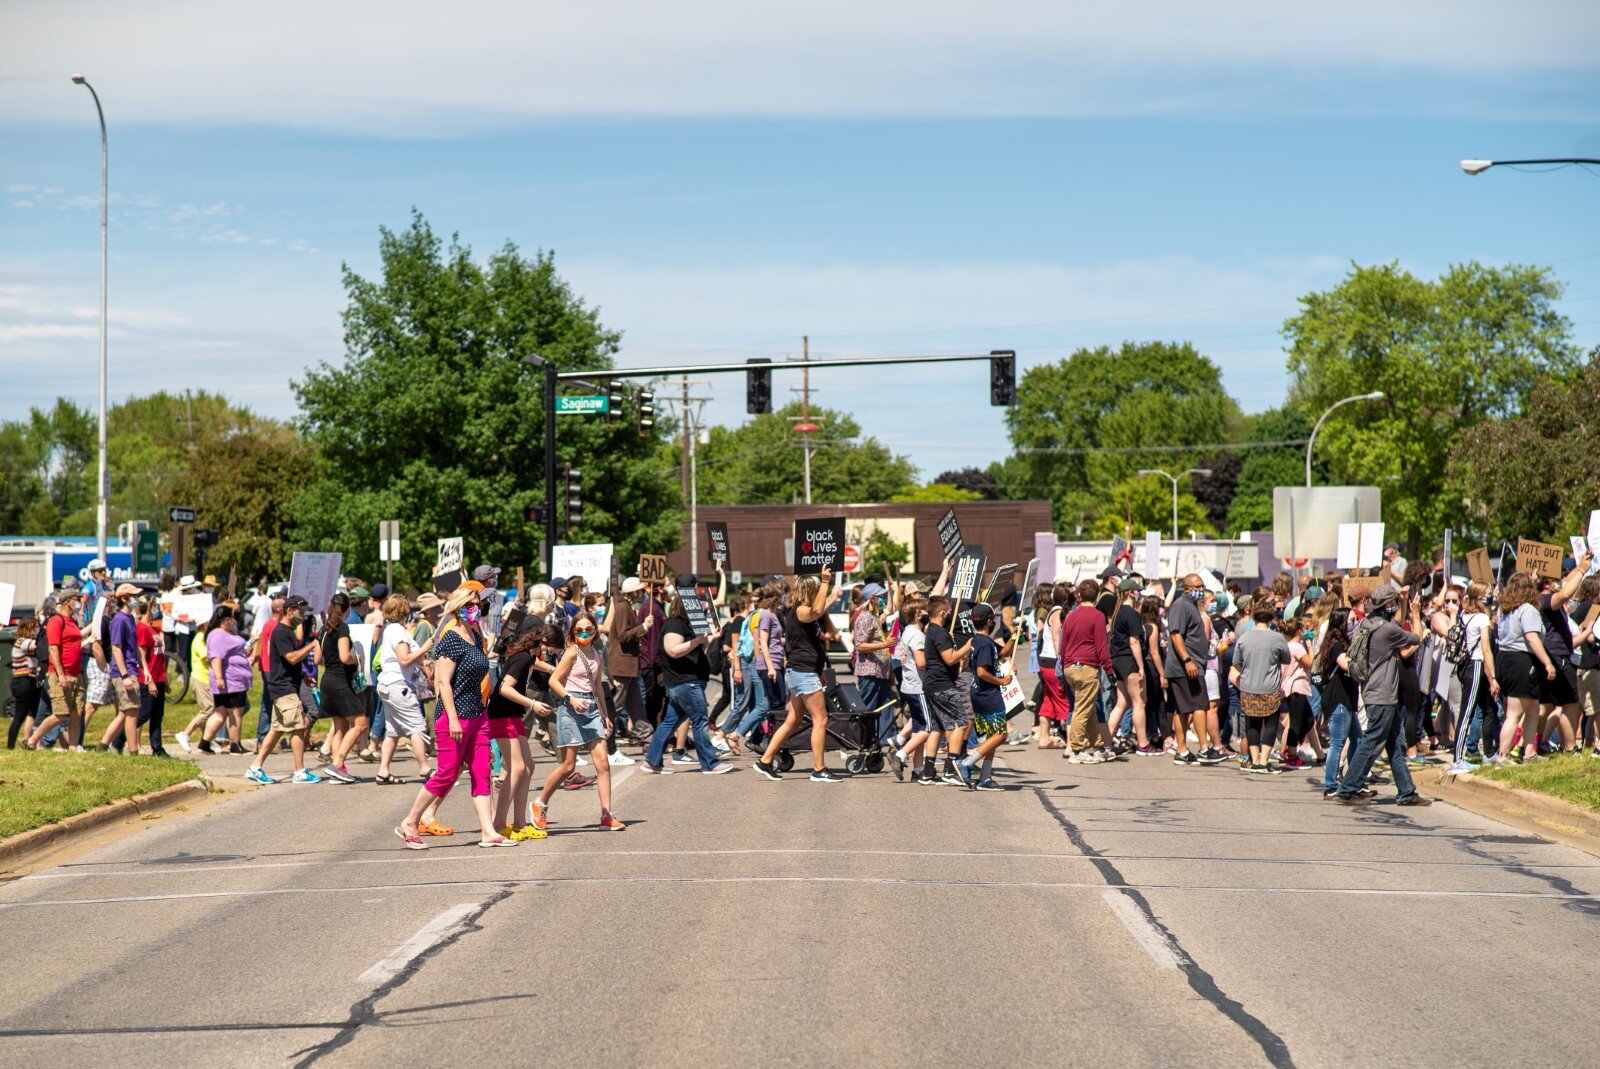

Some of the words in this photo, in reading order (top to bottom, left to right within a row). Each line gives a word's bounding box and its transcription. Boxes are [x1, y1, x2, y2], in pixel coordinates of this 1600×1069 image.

[561, 397, 604, 411] Saginaw
[711, 530, 724, 541] black
[806, 529, 833, 542] black
[940, 518, 958, 545] EQUALS
[812, 541, 838, 553] lives
[1520, 542, 1541, 556] VOTE
[1544, 547, 1561, 560] OUT
[801, 552, 836, 566] matter
[1525, 558, 1549, 572] HATE
[642, 558, 666, 579] BAD
[682, 599, 702, 611] EQUALS
